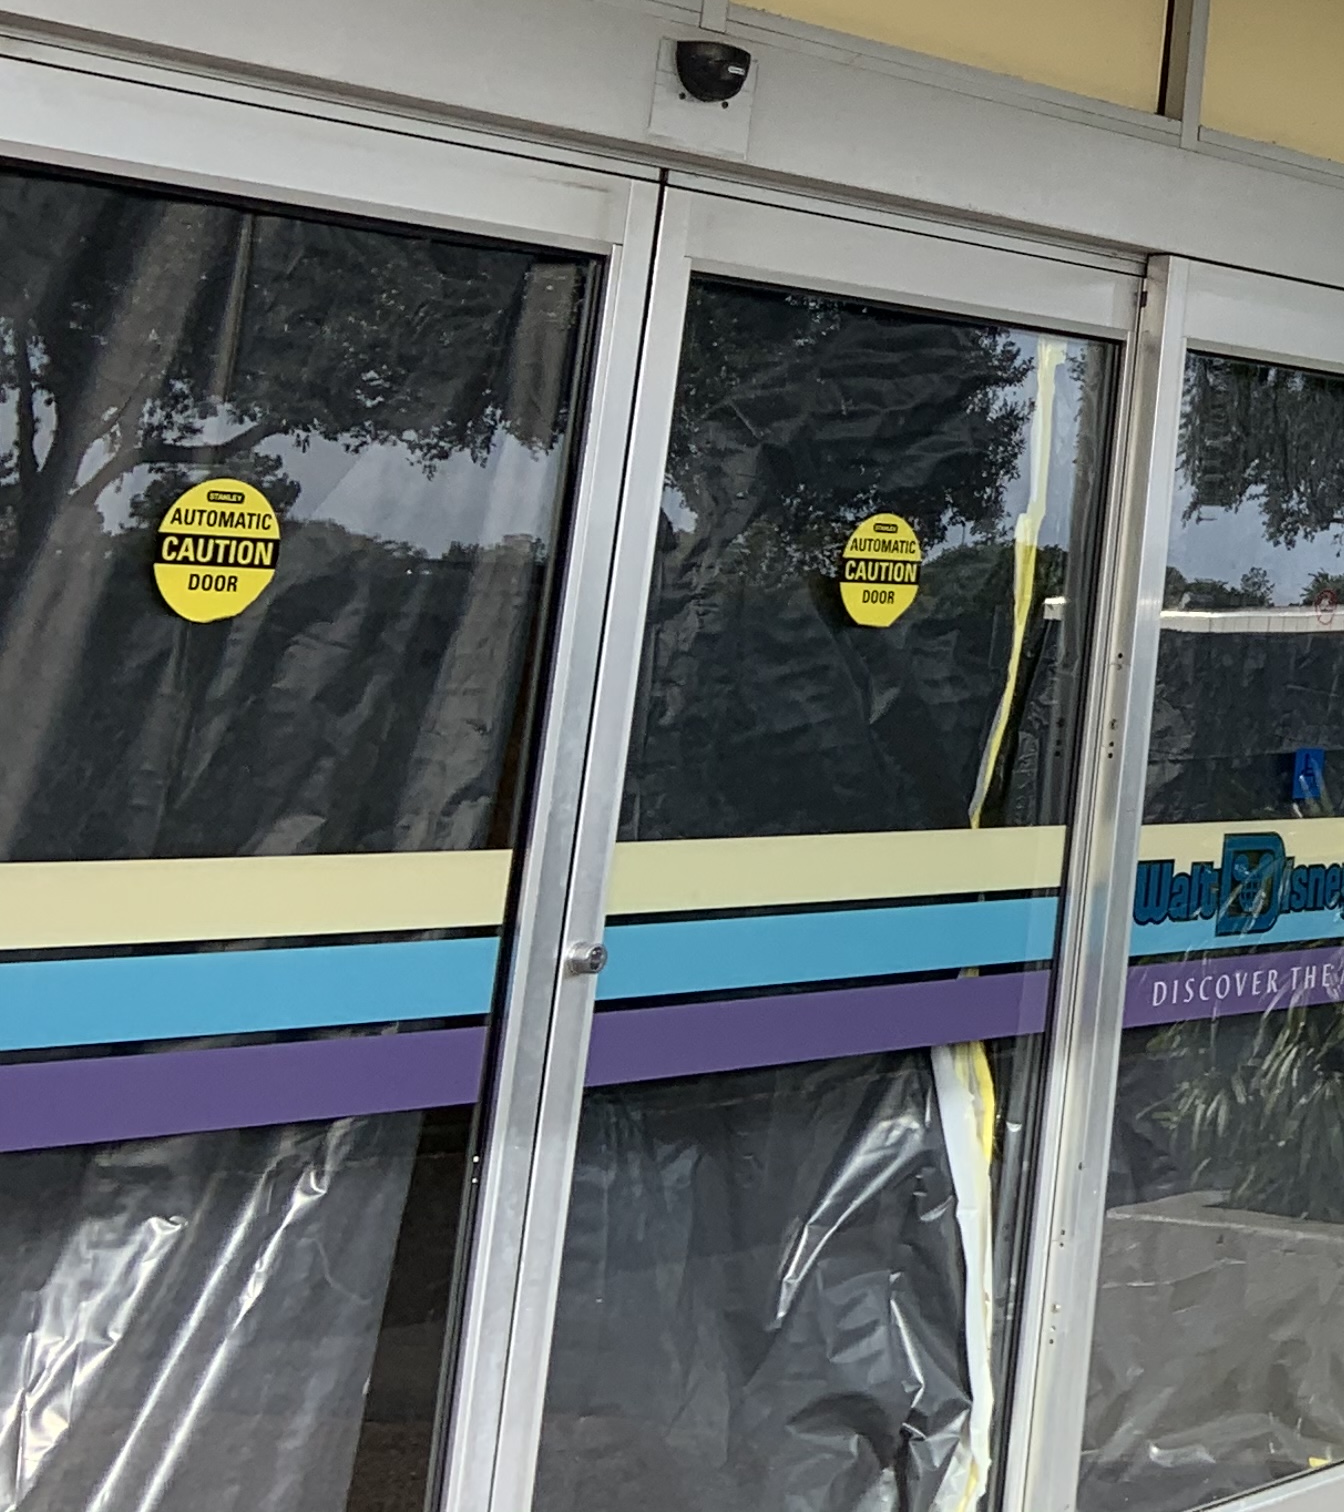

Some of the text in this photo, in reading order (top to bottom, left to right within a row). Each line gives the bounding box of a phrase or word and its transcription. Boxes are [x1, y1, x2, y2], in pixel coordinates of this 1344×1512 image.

[209, 492, 242, 501] STANLEY
[170, 508, 272, 530] AUTOMATIC
[162, 536, 273, 565] CAUTION
[850, 538, 916, 554] AUTOMATIC
[845, 560, 917, 582] CAUTION
[188, 573, 238, 592] DOOR
[862, 589, 895, 604] DOOR
[1133, 859, 1220, 926] Walt
[1152, 968, 1279, 1008] DISCOVER
[1290, 963, 1331, 991] THE
